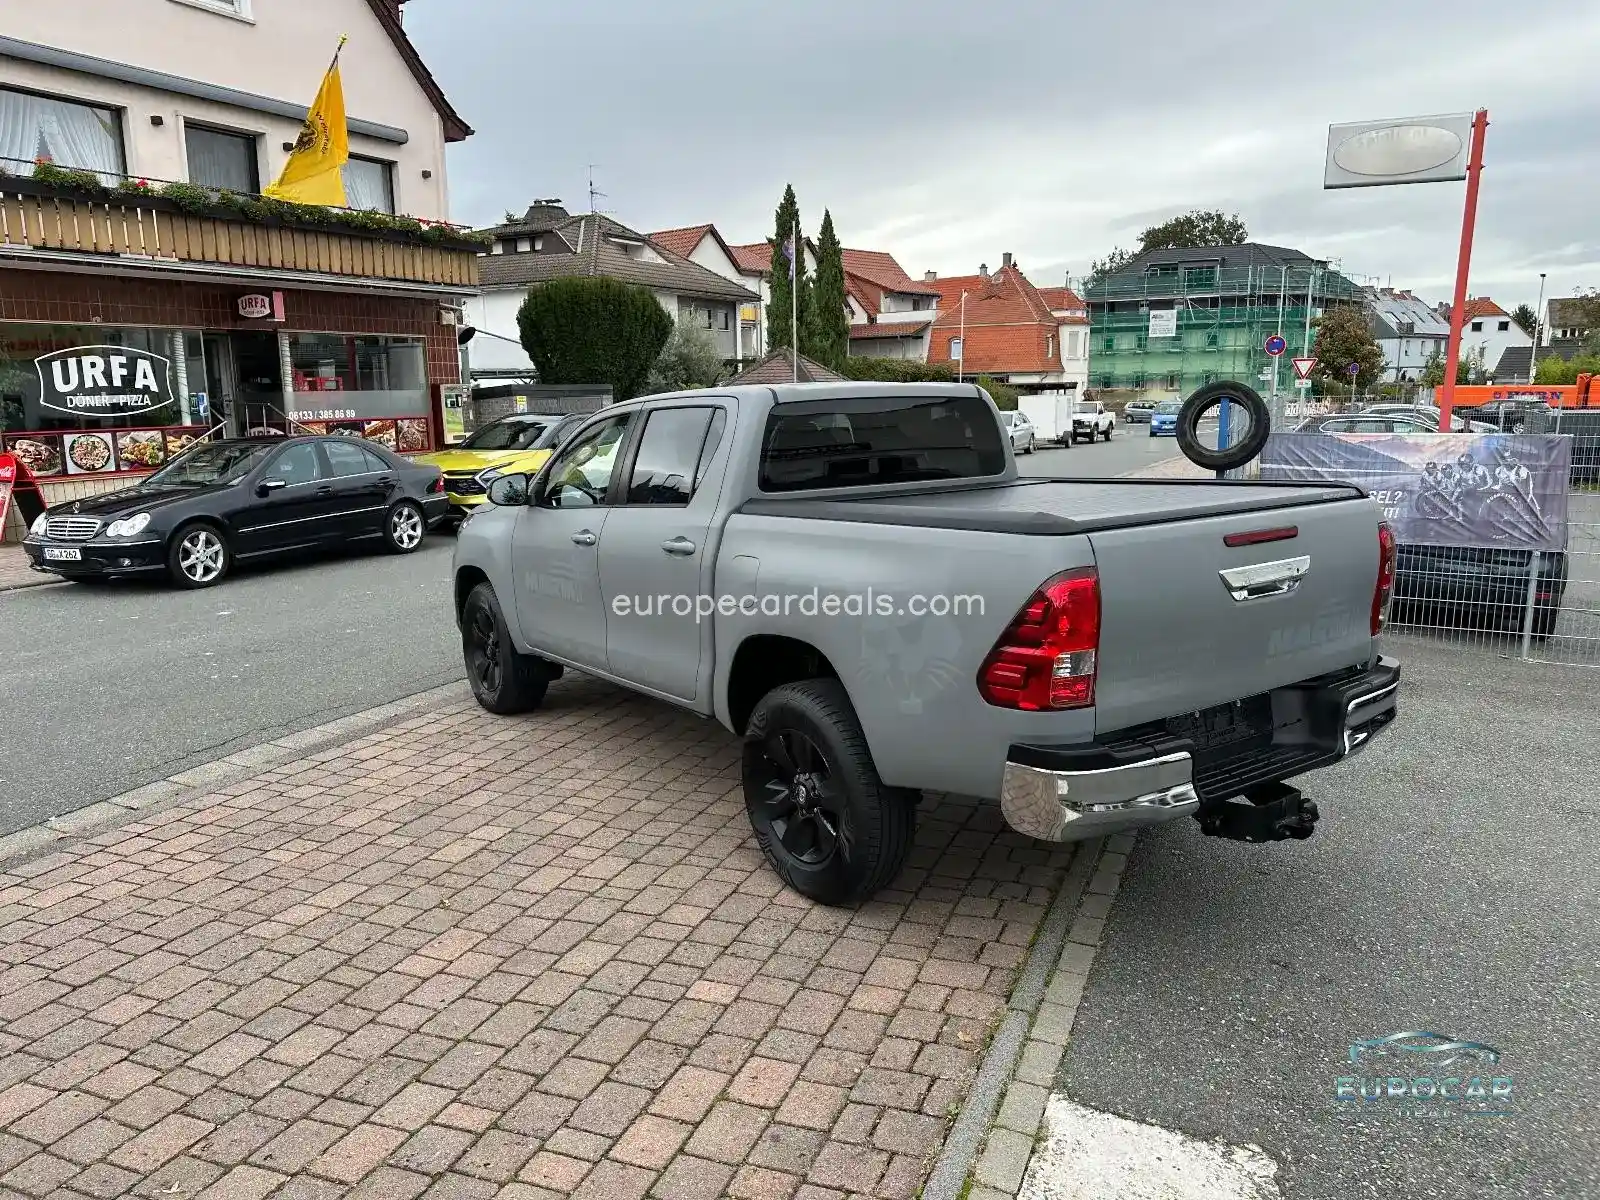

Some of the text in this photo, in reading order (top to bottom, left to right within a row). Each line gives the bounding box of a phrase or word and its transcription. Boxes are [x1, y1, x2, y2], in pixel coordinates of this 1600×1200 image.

[241, 298, 266, 310] URFA
[51, 355, 159, 393] URFA
[66, 393, 152, 408] DÖNER PIZZA
[288, 410, 313, 420] 06133
